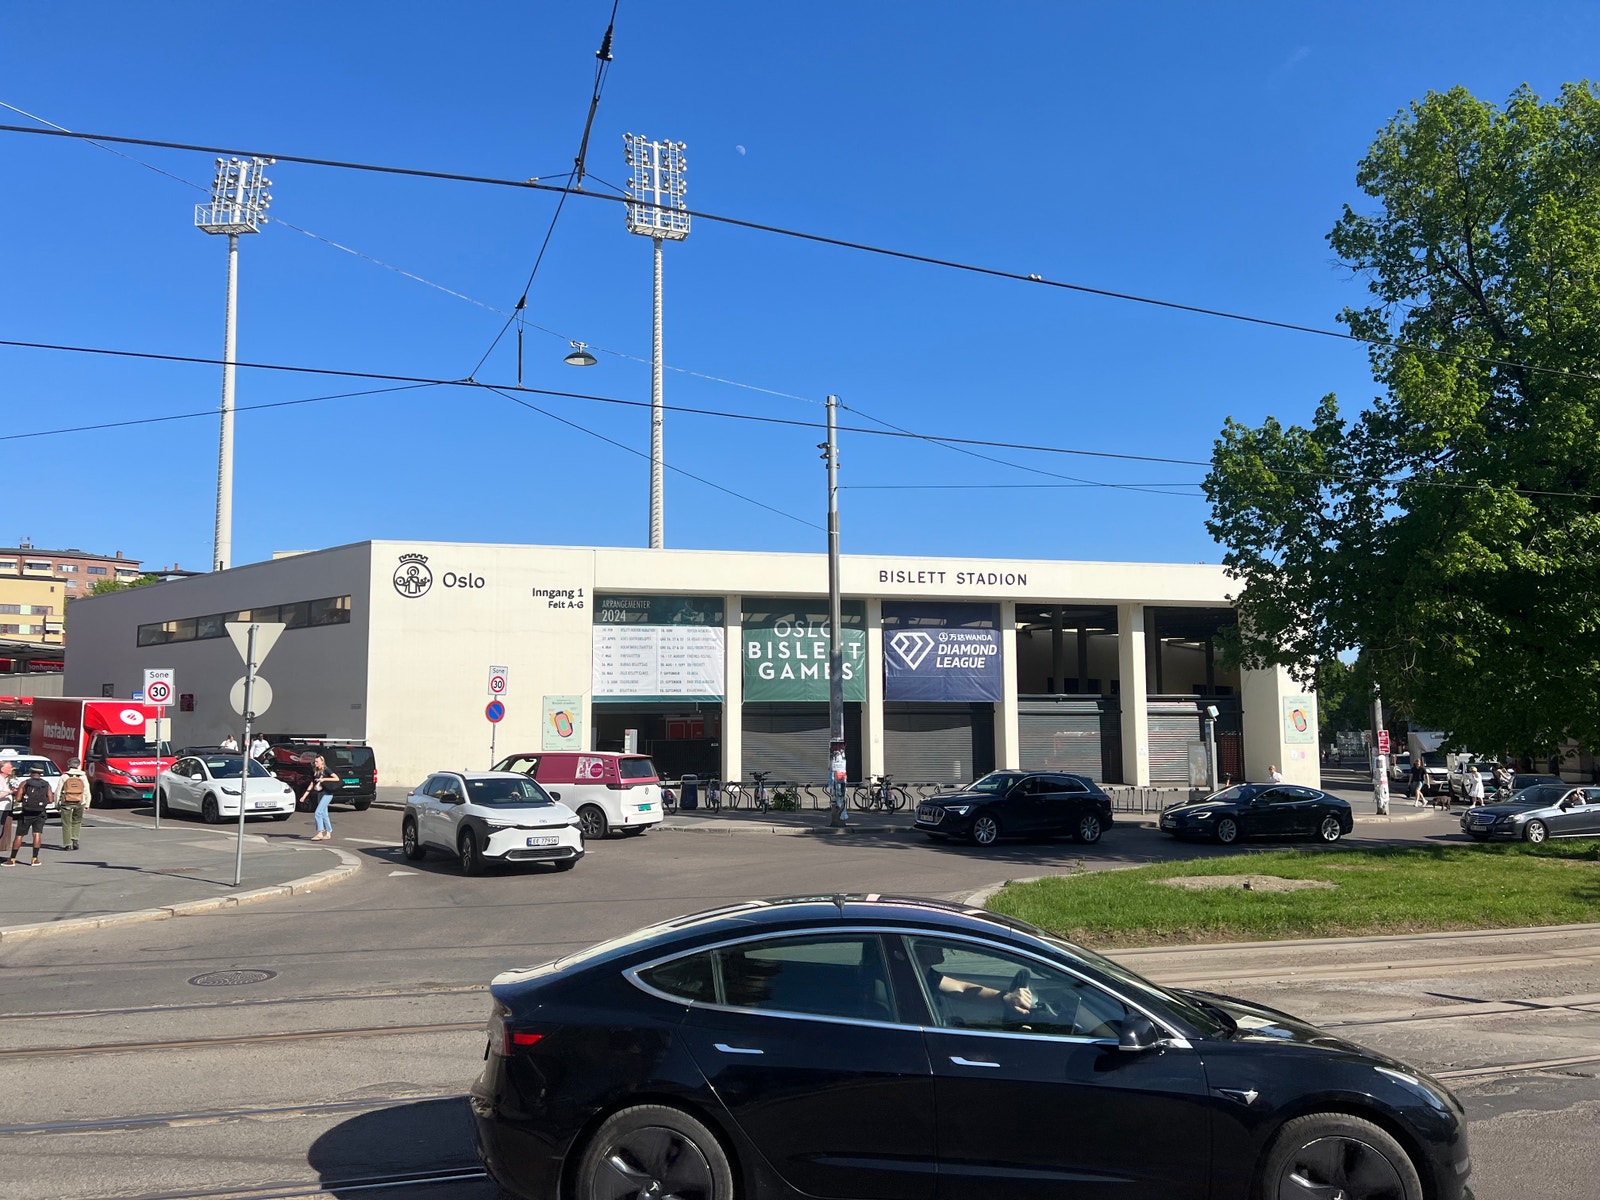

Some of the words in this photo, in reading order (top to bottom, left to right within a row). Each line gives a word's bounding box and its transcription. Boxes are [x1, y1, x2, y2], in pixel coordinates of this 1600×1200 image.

[442, 571, 486, 588] Oslo
[879, 570, 946, 584] BISLETT
[956, 572, 1027, 586] STADION
[532, 588, 575, 599] Inngang
[577, 588, 584, 597] 1
[548, 600, 566, 609] Felt
[567, 601, 584, 609] A-G
[601, 600, 651, 609] ARRANGEMENTER
[601, 609, 626, 622] 2024
[748, 641, 861, 659] BISLET
[938, 644, 998, 656] DIAMOND
[936, 657, 985, 669] LEAGUE
[493, 680, 502, 689] 30
[152, 686, 167, 697] 30
[43, 720, 76, 741] instabox
